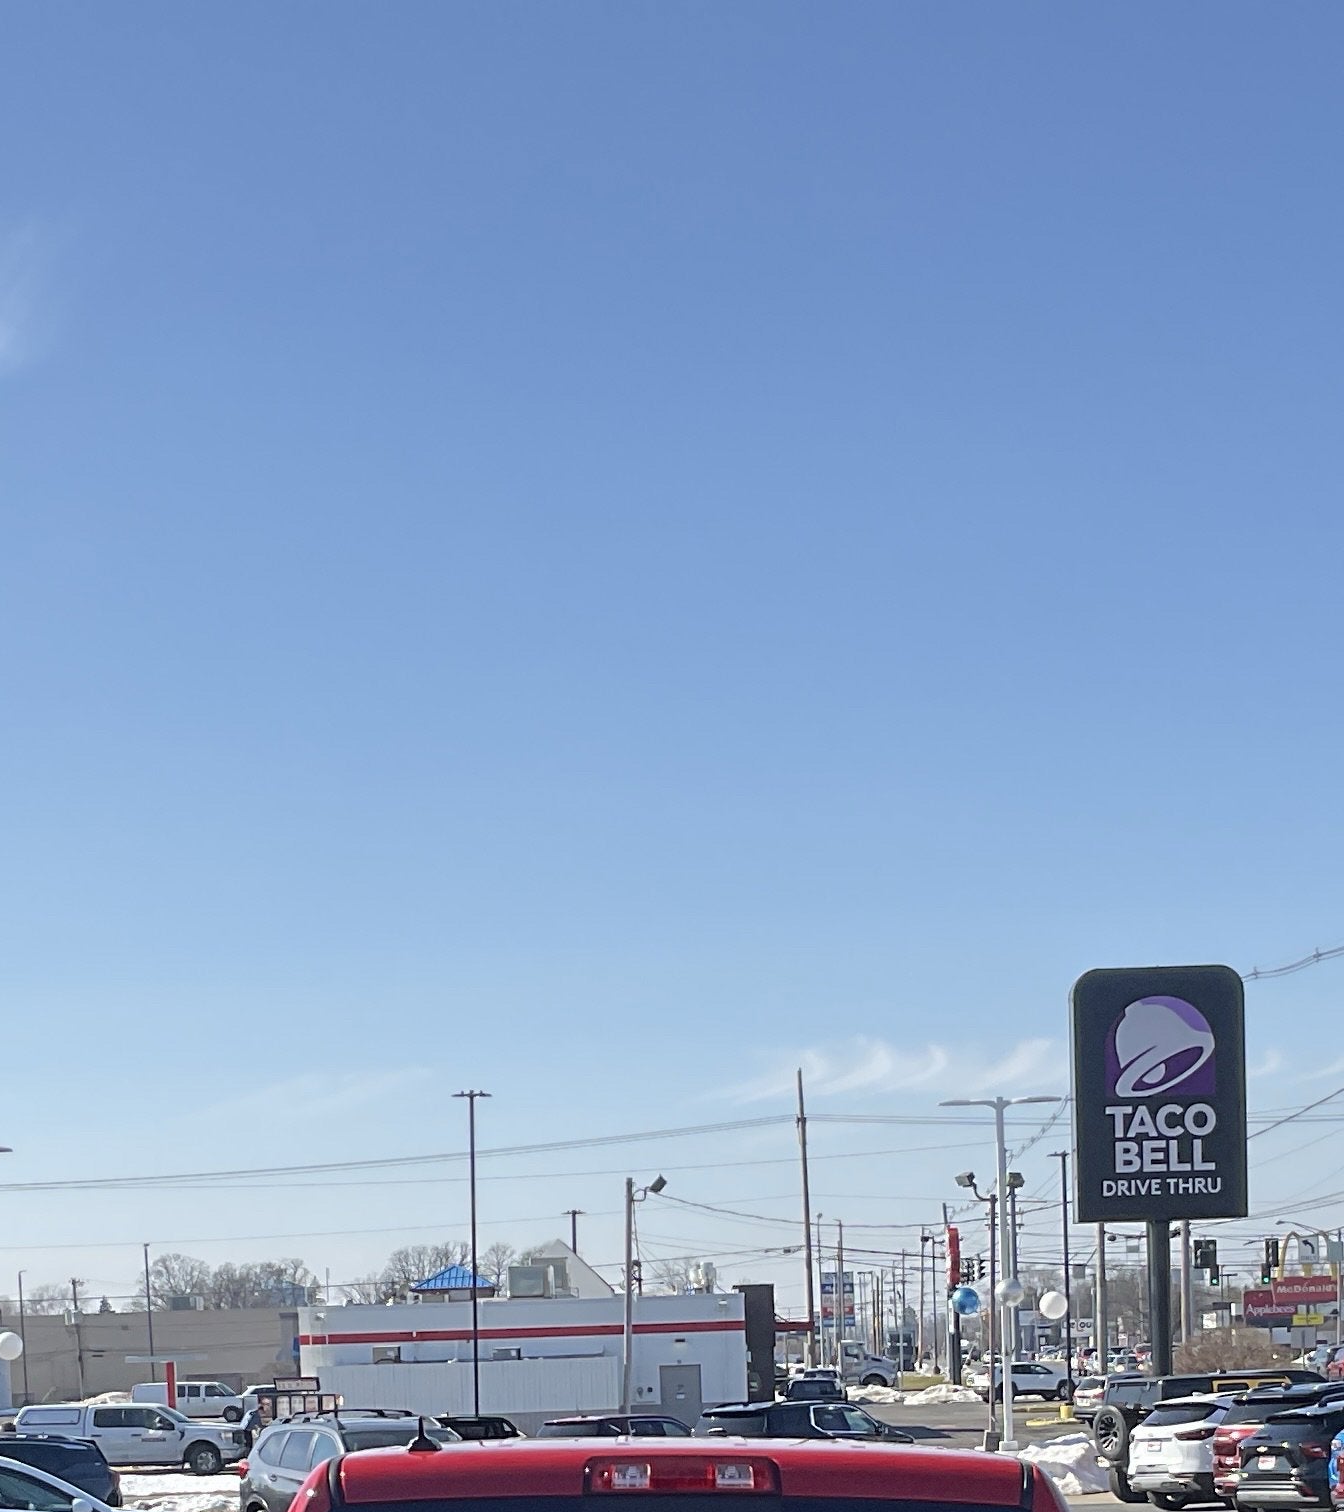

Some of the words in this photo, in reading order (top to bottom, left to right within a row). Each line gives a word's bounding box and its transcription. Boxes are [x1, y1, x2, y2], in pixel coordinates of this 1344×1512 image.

[1105, 1103, 1217, 1138] TACO
[1115, 1139, 1216, 1174] BELL
[1102, 1179, 1162, 1197] DRIVE
[1166, 1177, 1222, 1195] THRU
